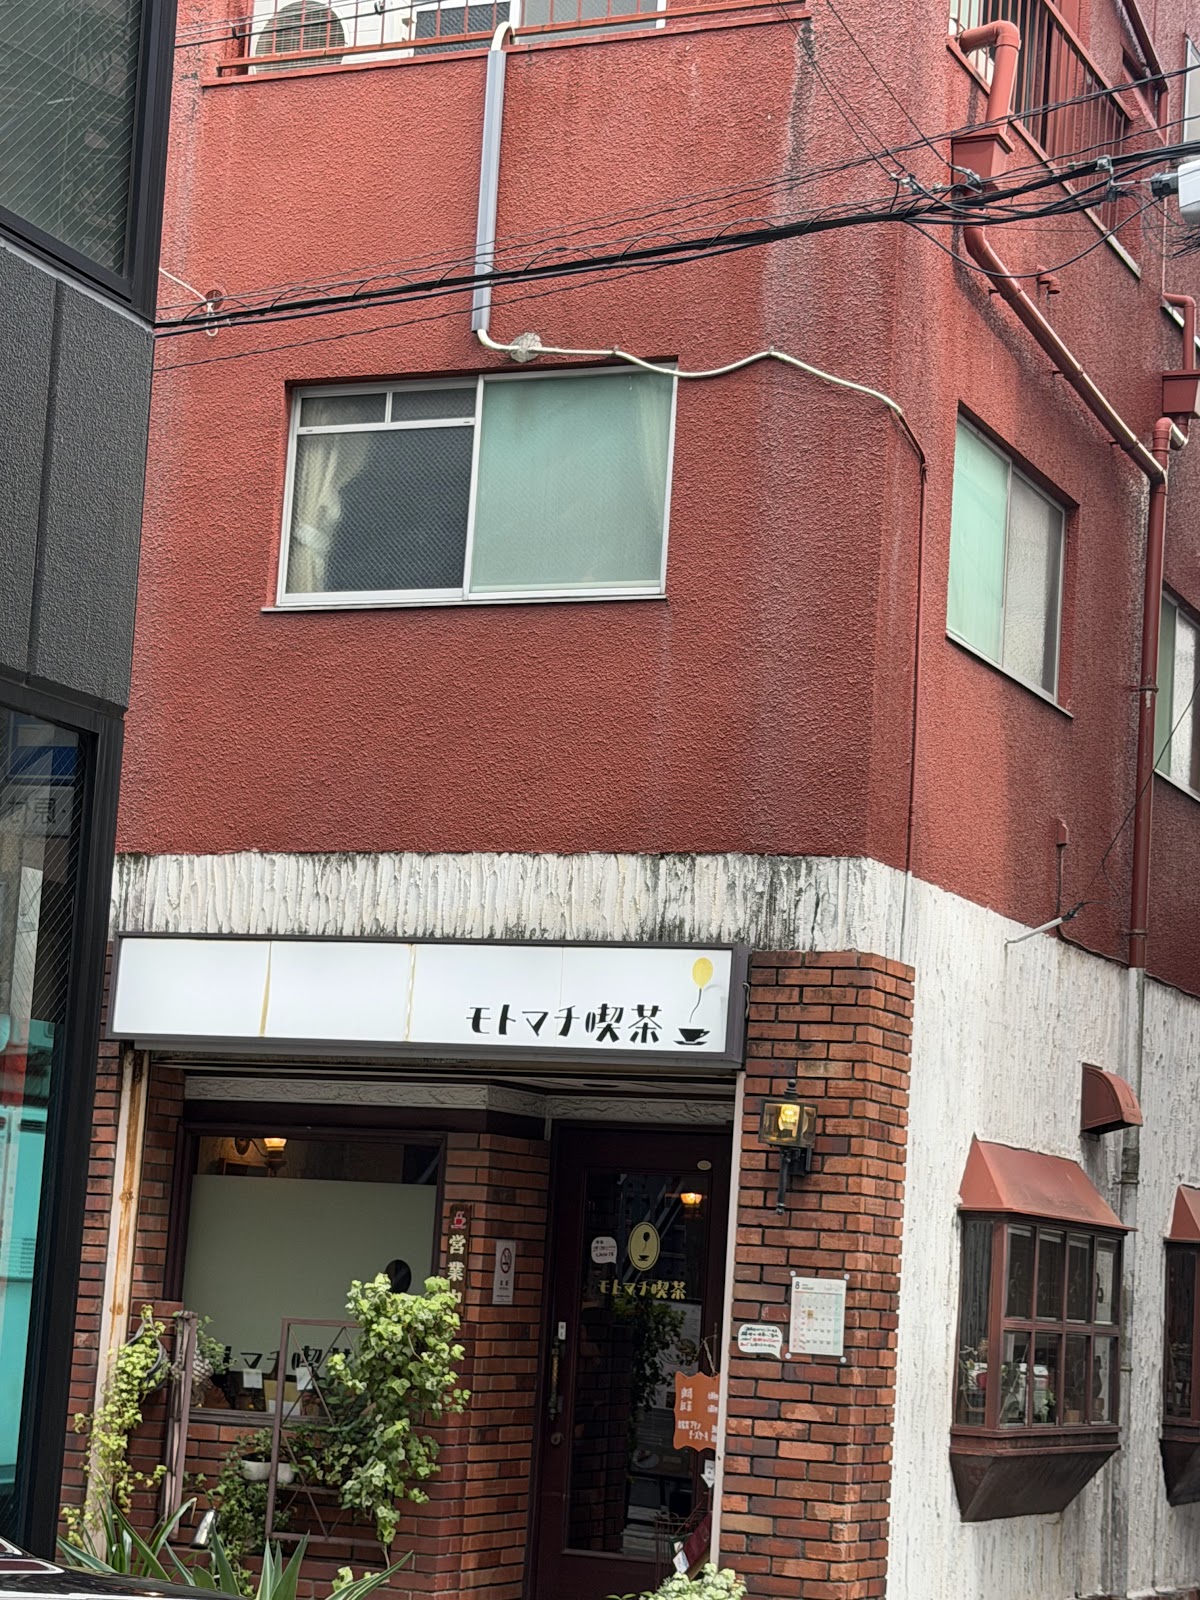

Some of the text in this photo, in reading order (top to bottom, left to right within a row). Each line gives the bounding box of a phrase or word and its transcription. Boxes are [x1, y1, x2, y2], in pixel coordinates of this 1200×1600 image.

[466, 1003, 663, 1043] モトマチ喫茶
[598, 1279, 687, 1300] モトマチ喫茶
[794, 1281, 800, 1290] 8
